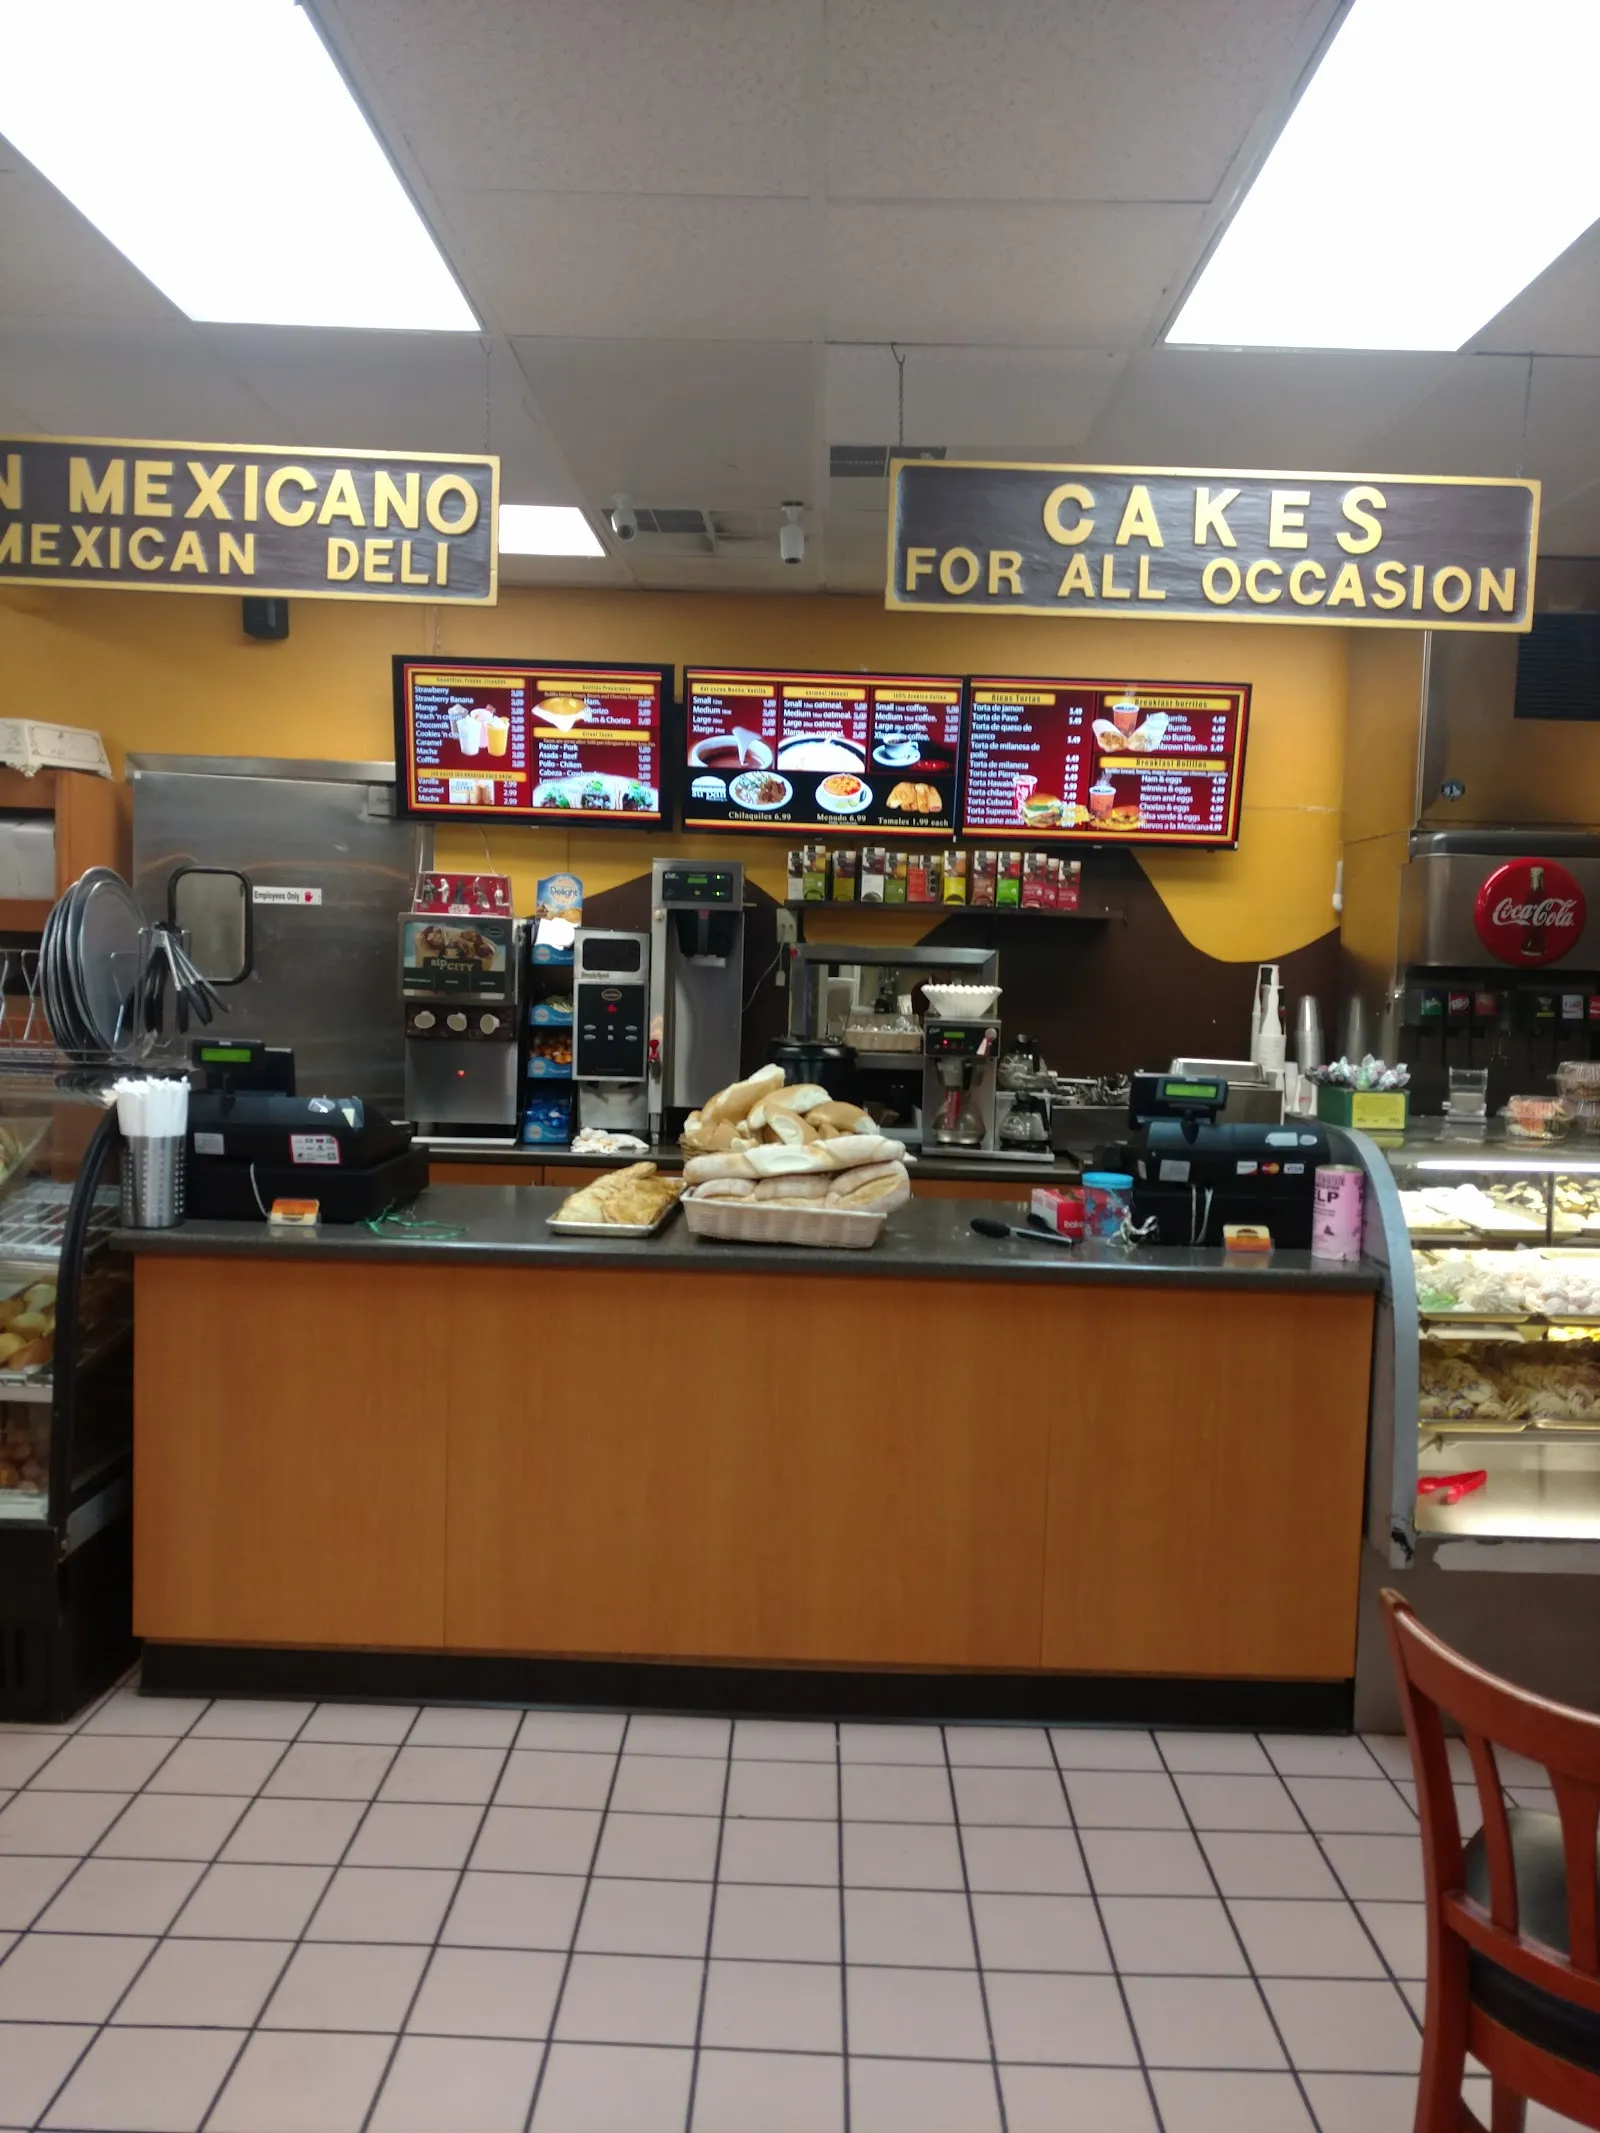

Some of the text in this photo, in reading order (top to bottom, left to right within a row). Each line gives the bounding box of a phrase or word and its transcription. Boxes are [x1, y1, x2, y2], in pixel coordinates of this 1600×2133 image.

[69, 457, 478, 535] MEXICANO
[1043, 484, 1387, 554] CAKES
[327, 538, 448, 586] DELI
[906, 547, 1515, 612] FOR ALL OCCASION
[415, 695, 449, 704] Strawberry
[784, 700, 802, 708] Small
[415, 704, 438, 712] Mango
[693, 706, 720, 714] Medium
[876, 703, 894, 711] Small
[784, 710, 811, 718] Medium
[875, 712, 903, 721] Medium
[693, 716, 711, 724] Large
[783, 719, 802, 728] Large
[692, 725, 714, 733] Xlarge
[875, 722, 893, 731] Large
[1184, 744, 1208, 752] Burrito
[728, 811, 791, 821] Chilaquiles 6.99
[986, 808, 1016, 816] Suprema
[817, 813, 866, 823] Menudo 6.99
[878, 817, 910, 825] Tamales
[912, 818, 929, 826] 1.99
[254, 890, 300, 902] Employees Only
[550, 886, 578, 899] Delight
[1492, 897, 1577, 926] Coca-Cola
